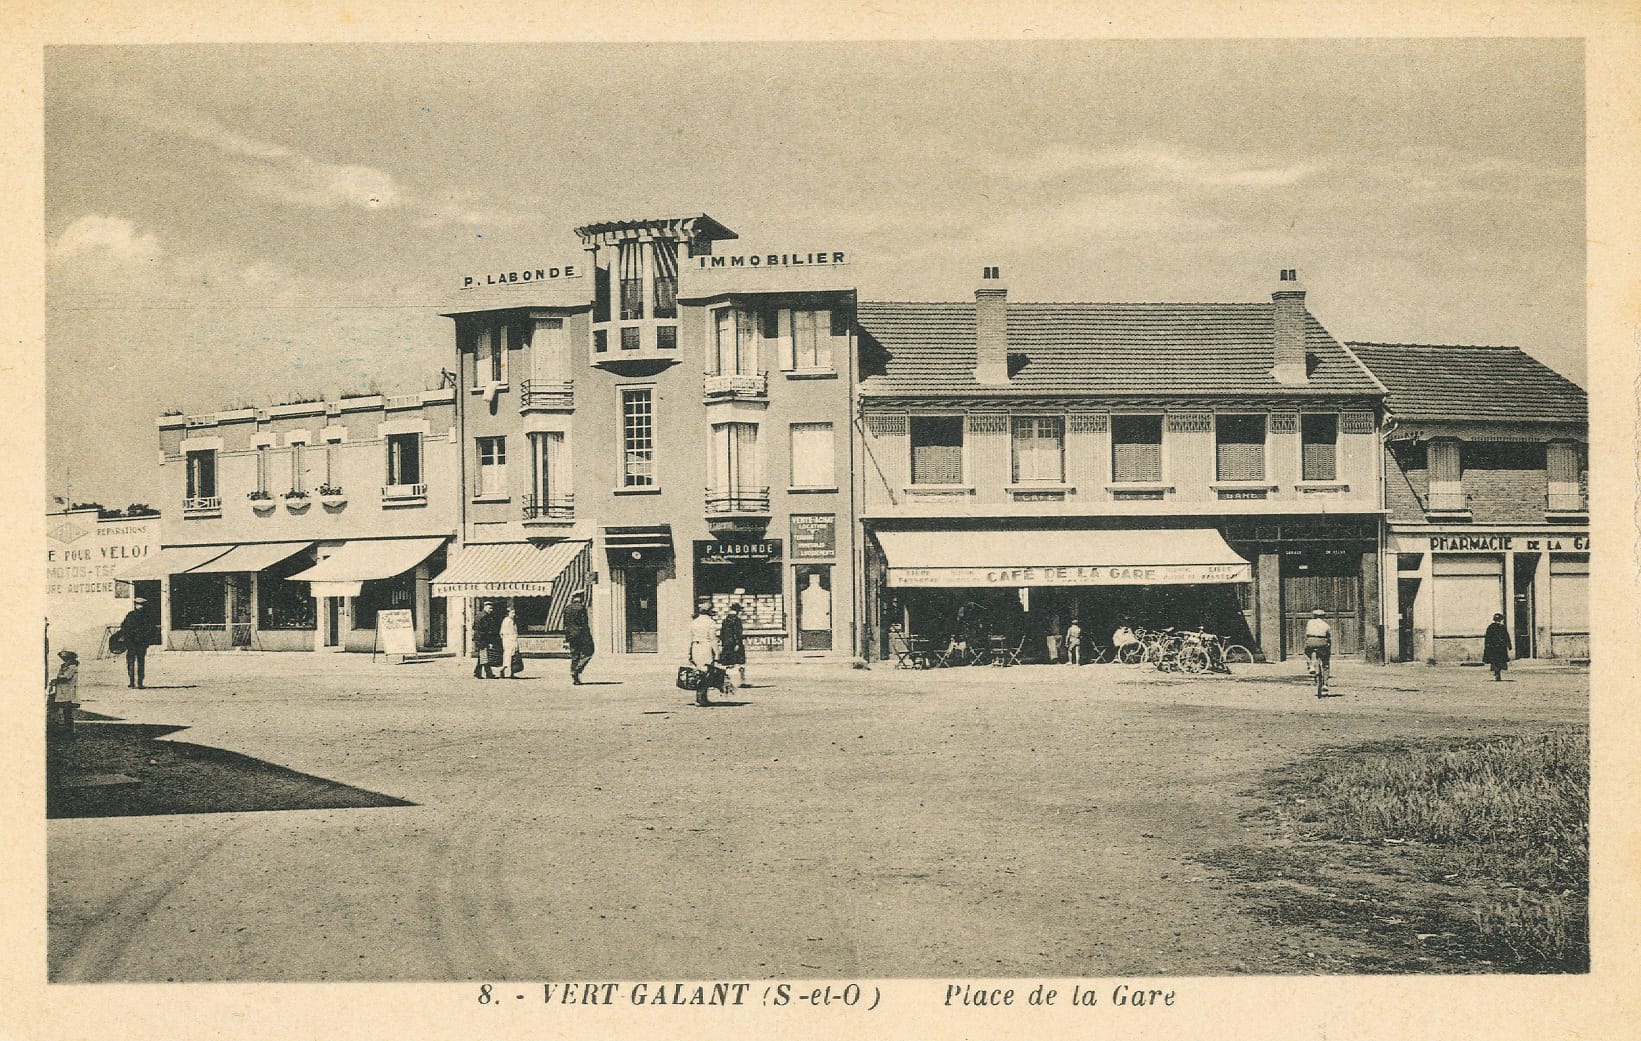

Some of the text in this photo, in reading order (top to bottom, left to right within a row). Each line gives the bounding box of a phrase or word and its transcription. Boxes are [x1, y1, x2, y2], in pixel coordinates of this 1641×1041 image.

[700, 252, 845, 267] IMMOBILIER
[464, 266, 575, 287] P. LABONDE
[719, 544, 773, 554] LABONDE
[1430, 536, 1512, 551] PHARMACIE
[1527, 540, 1540, 550] DE
[1547, 540, 1562, 550] LA
[64, 549, 91, 561] POUR
[100, 545, 148, 559] VELOS
[1044, 567, 1067, 579] DE
[1077, 567, 1100, 578] LA
[1109, 568, 1156, 580] GARE
[746, 637, 783, 645] VENTES
